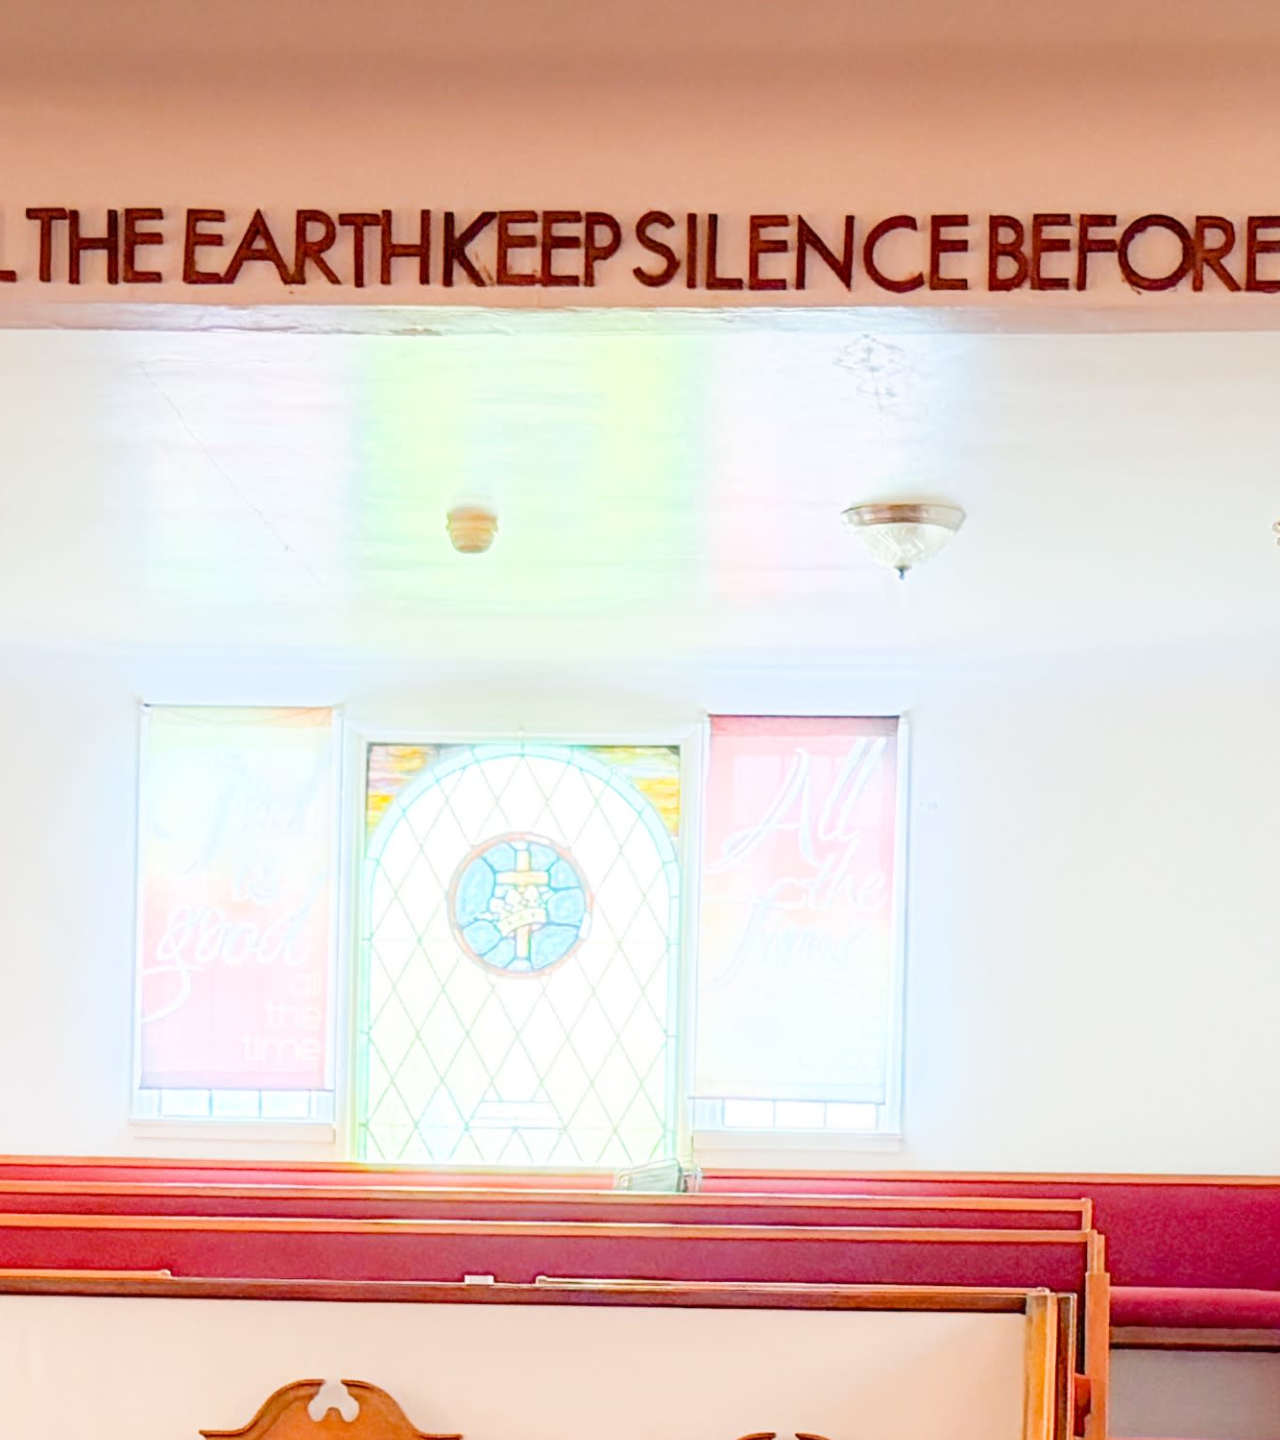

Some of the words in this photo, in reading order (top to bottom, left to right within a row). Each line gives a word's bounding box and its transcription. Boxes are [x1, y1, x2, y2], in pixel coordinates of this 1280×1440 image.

[26, 208, 164, 285] THE
[183, 209, 432, 288] EARTH
[443, 211, 622, 288] KEEP
[633, 211, 968, 291] SILENCE
